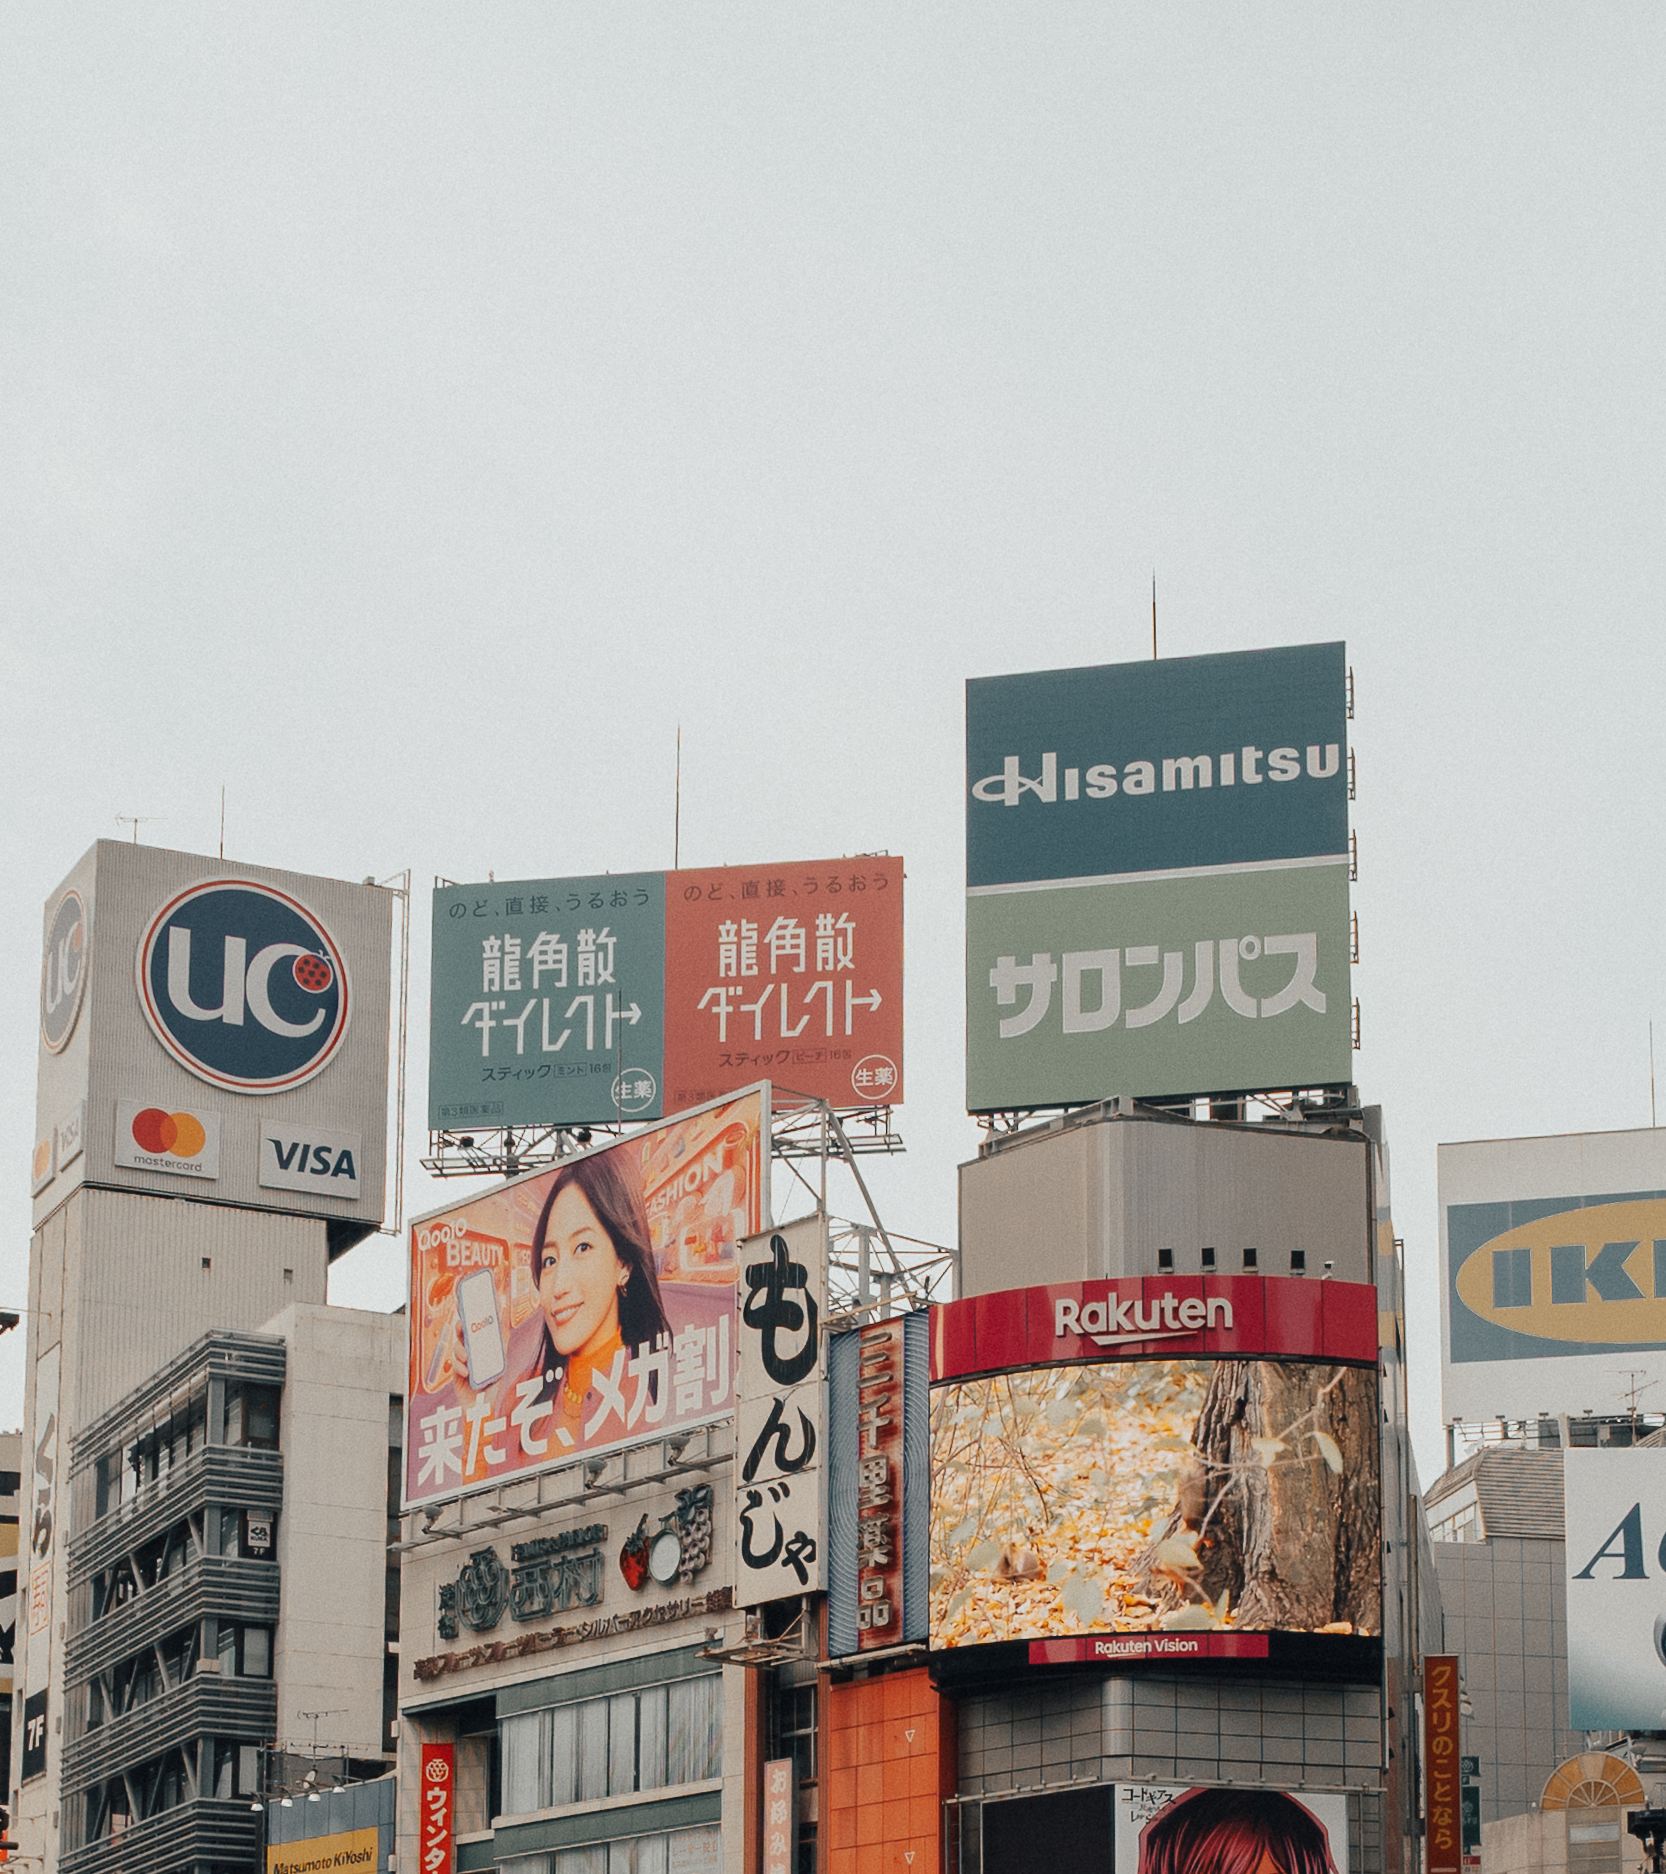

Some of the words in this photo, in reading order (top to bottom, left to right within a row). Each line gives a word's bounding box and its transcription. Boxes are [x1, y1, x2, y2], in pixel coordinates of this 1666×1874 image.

[972, 743, 1339, 806] Hisamitsu
[449, 887, 650, 920] のど、直接、うるおう
[684, 873, 889, 902] のど、直接、うるおう
[481, 927, 617, 993] 龍角散
[718, 912, 857, 978] 龍角散
[990, 932, 1326, 1038] サロンパス
[460, 991, 642, 1057] ダイレクト
[697, 979, 883, 1042] ダイレクト
[481, 1064, 551, 1082] スティック
[557, 1063, 585, 1077] ミント
[718, 1050, 790, 1068] スティック
[855, 1065, 894, 1089] 生薬
[613, 1080, 655, 1102] 生薬
[134, 1155, 202, 1172] mastercard
[266, 1138, 357, 1180] VISA
[446, 1240, 504, 1267] BEAUTY
[1055, 1292, 1233, 1337] Rakuten
[418, 1314, 729, 1486] 来たぞ、メガ割
[742, 1235, 819, 1585] もんじゃ
[857, 1330, 892, 1631] 三千里薬品
[1095, 1639, 1152, 1657] Rakuten
[1155, 1637, 1198, 1653] Vision
[27, 1714, 44, 1751] 7F
[1432, 1664, 1458, 1851] クスリのことなら
[1122, 1787, 1176, 1804] コードギアス
